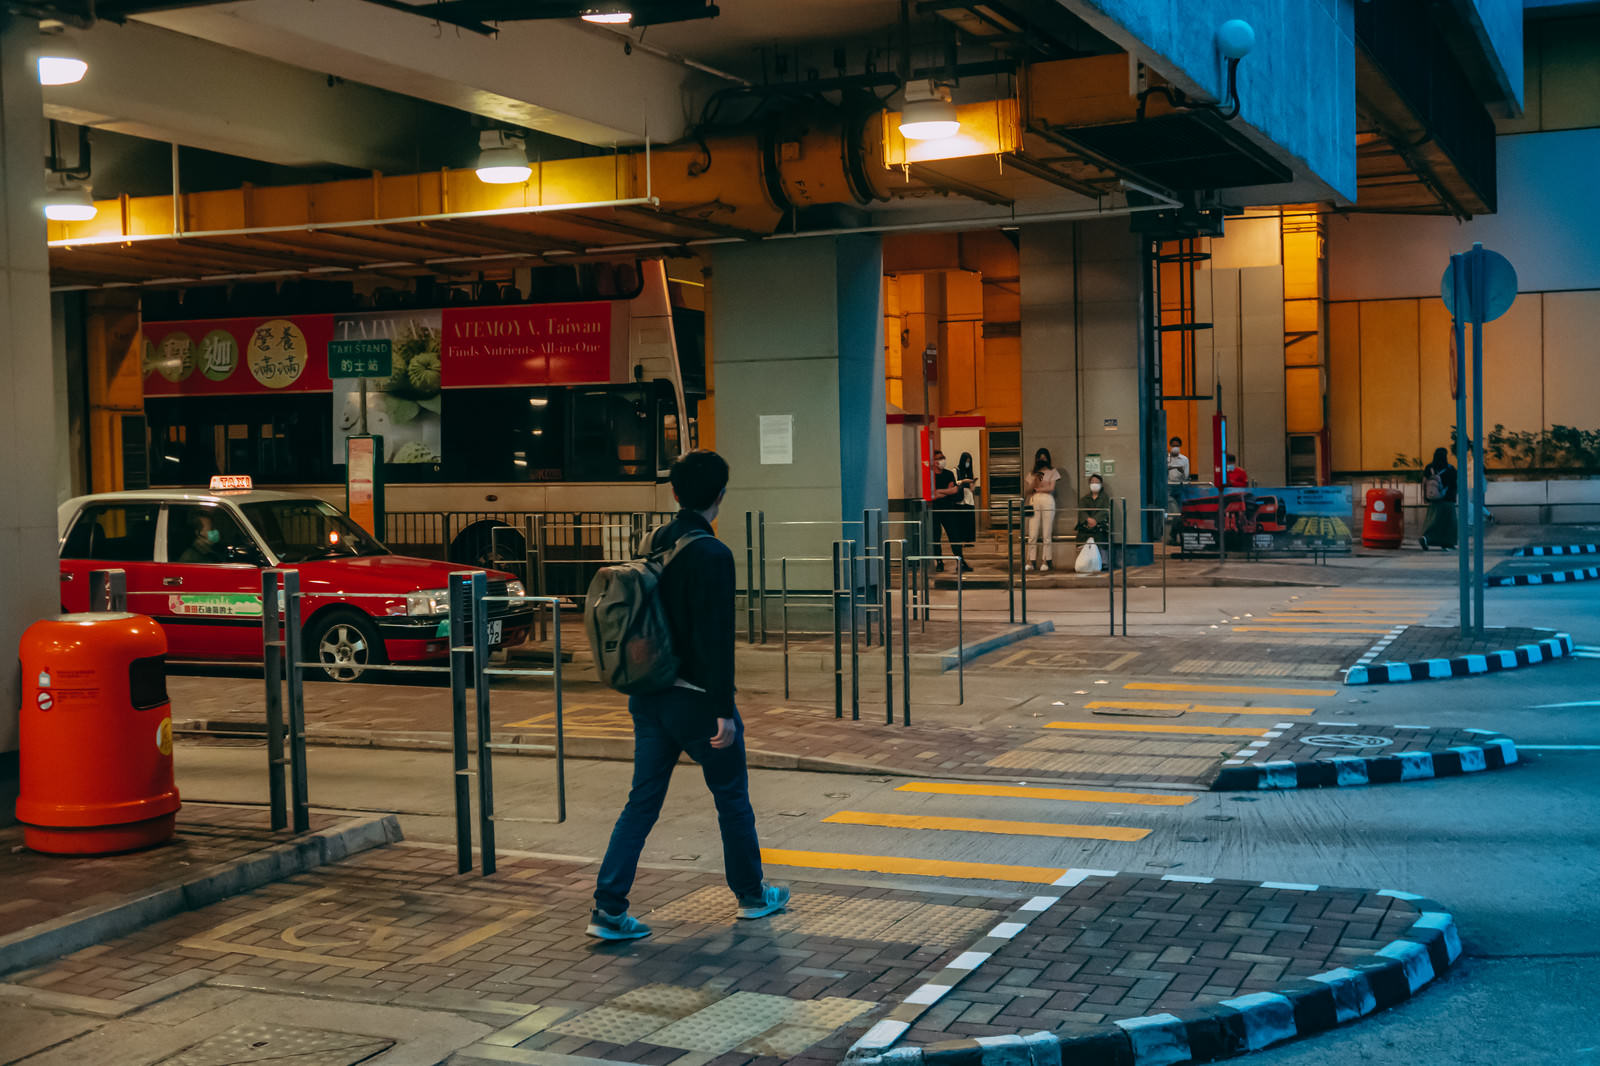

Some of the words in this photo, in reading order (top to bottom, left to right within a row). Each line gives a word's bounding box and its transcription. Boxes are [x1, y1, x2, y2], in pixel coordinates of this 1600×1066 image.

[547, 317, 602, 335] Taiwan
[331, 344, 352, 353] TAXI
[355, 342, 388, 353] STAND
[483, 344, 535, 356] Nutrients
[541, 341, 601, 354] All-in-One
[341, 358, 379, 373] 的士站
[220, 476, 250, 488] TAXI
